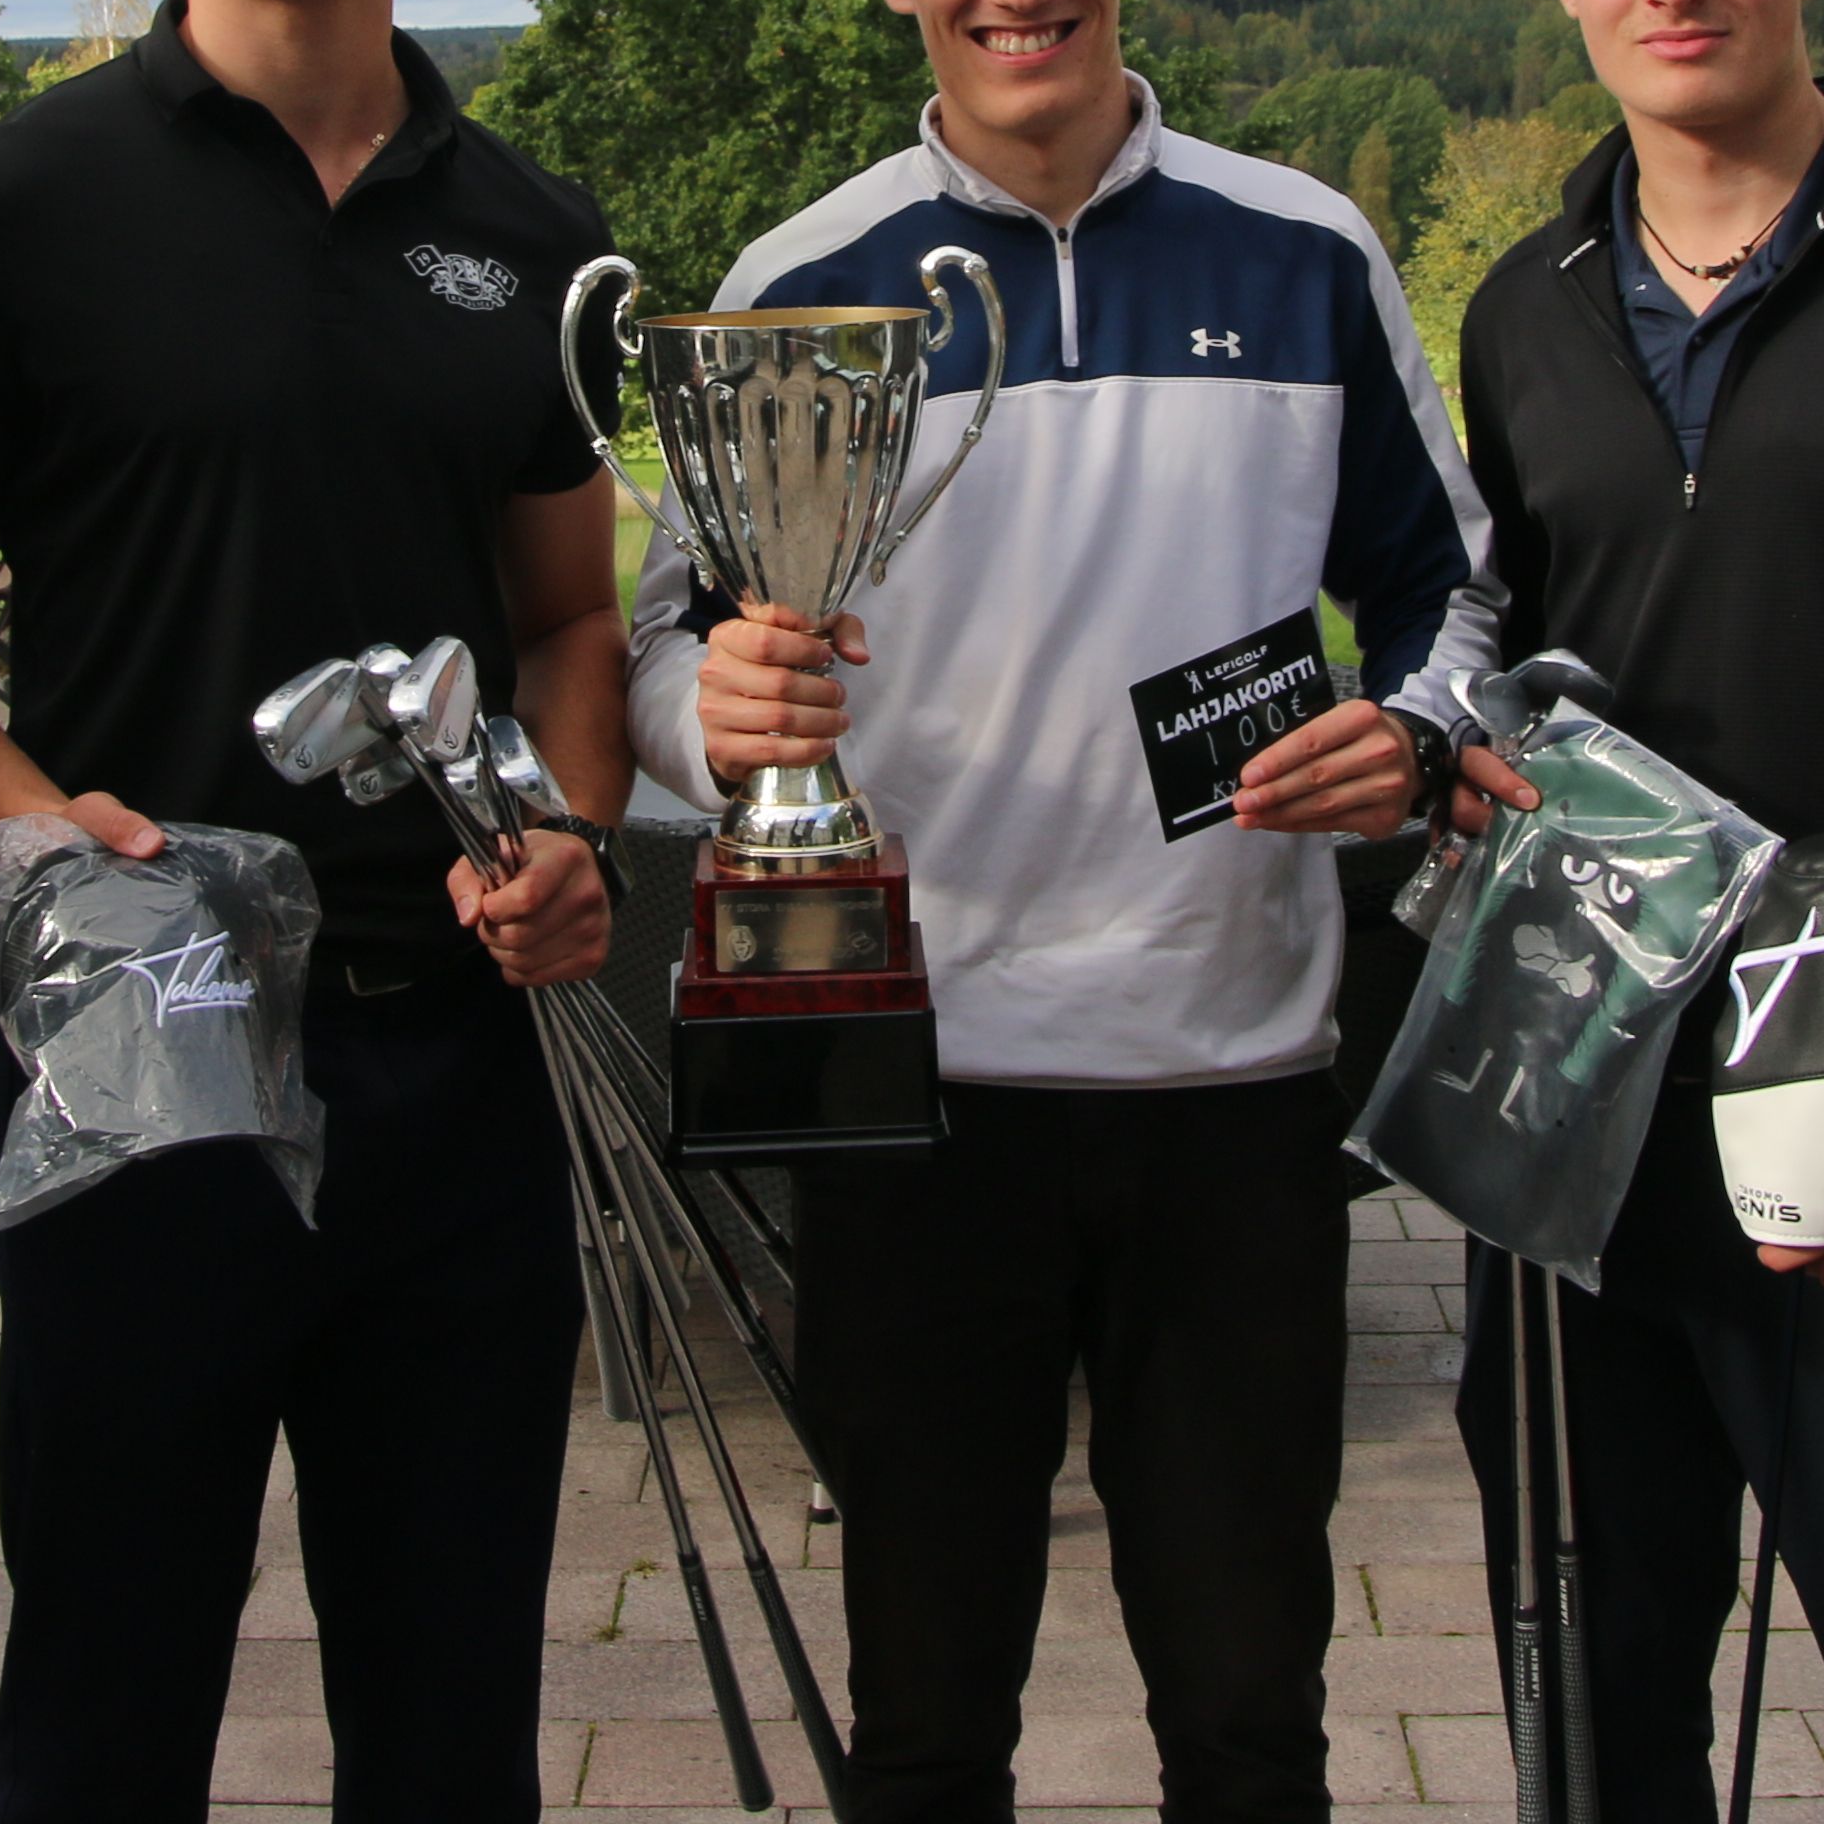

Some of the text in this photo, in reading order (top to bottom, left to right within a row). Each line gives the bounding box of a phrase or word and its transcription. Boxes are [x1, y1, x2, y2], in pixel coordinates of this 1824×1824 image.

[1204, 644, 1269, 680] LEFIGOLF
[1156, 654, 1317, 743] LAHJAKORTTI
[1531, 1648, 1540, 1698] LAMKIN
